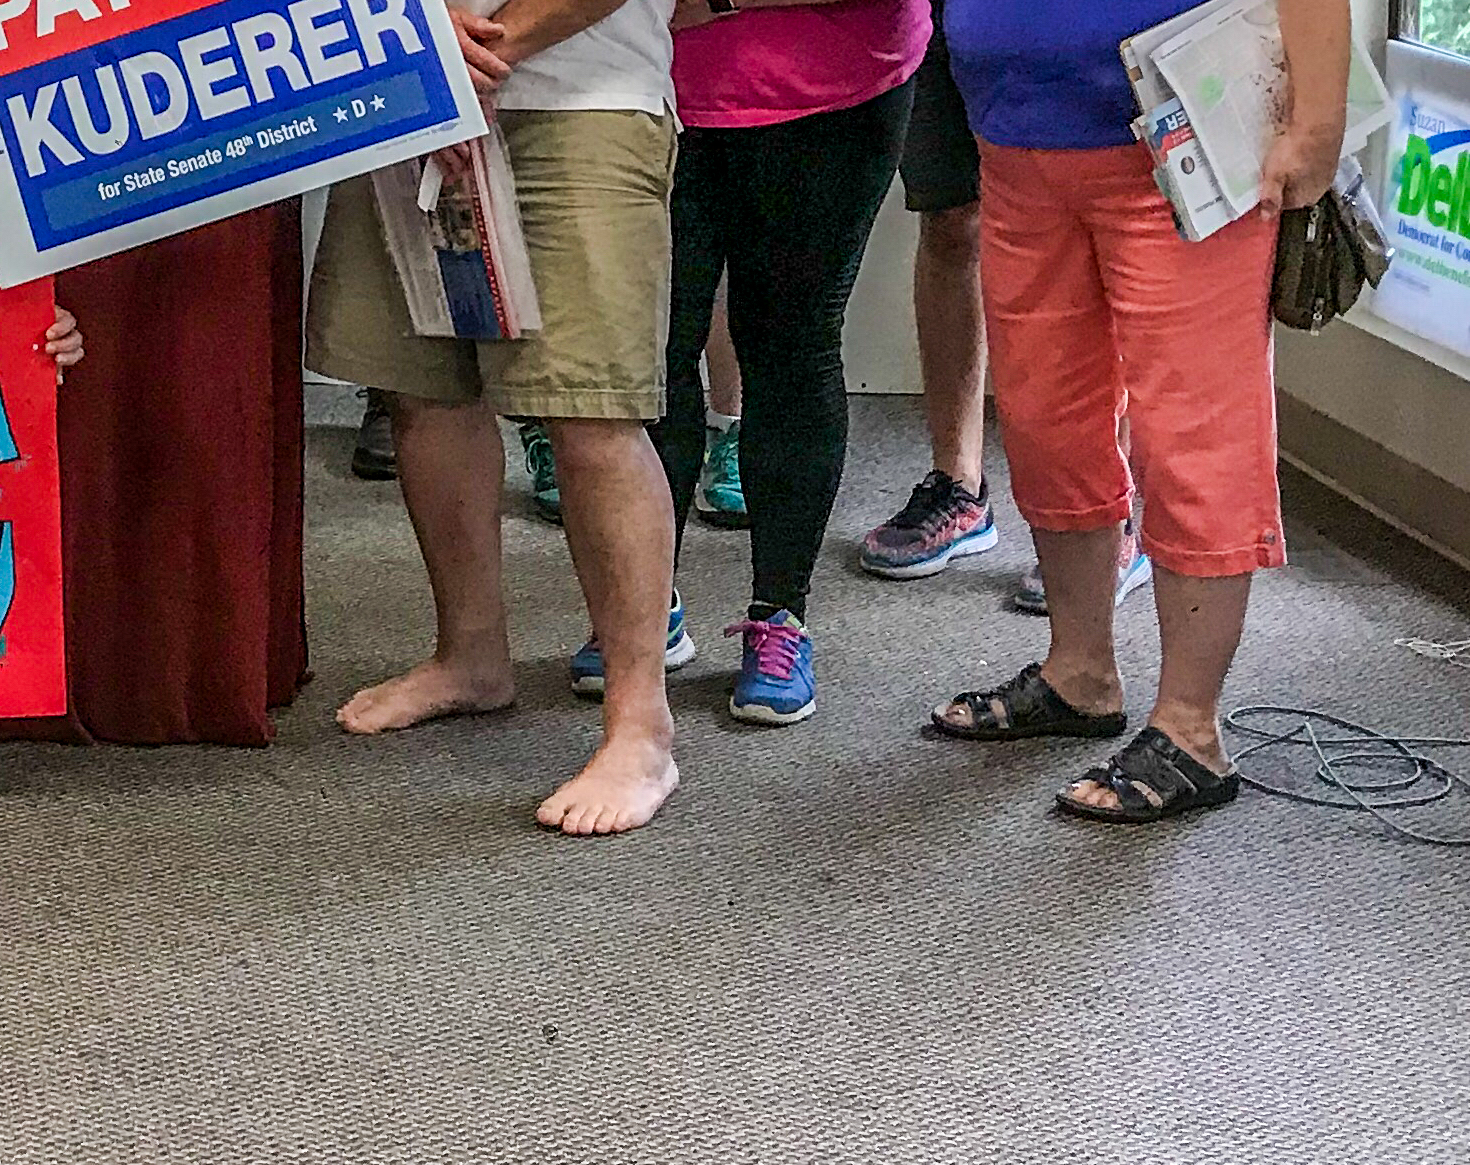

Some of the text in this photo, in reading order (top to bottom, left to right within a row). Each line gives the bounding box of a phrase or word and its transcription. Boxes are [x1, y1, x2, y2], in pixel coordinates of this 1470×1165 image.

[98, 97, 367, 201] for State Senate 48th District D
